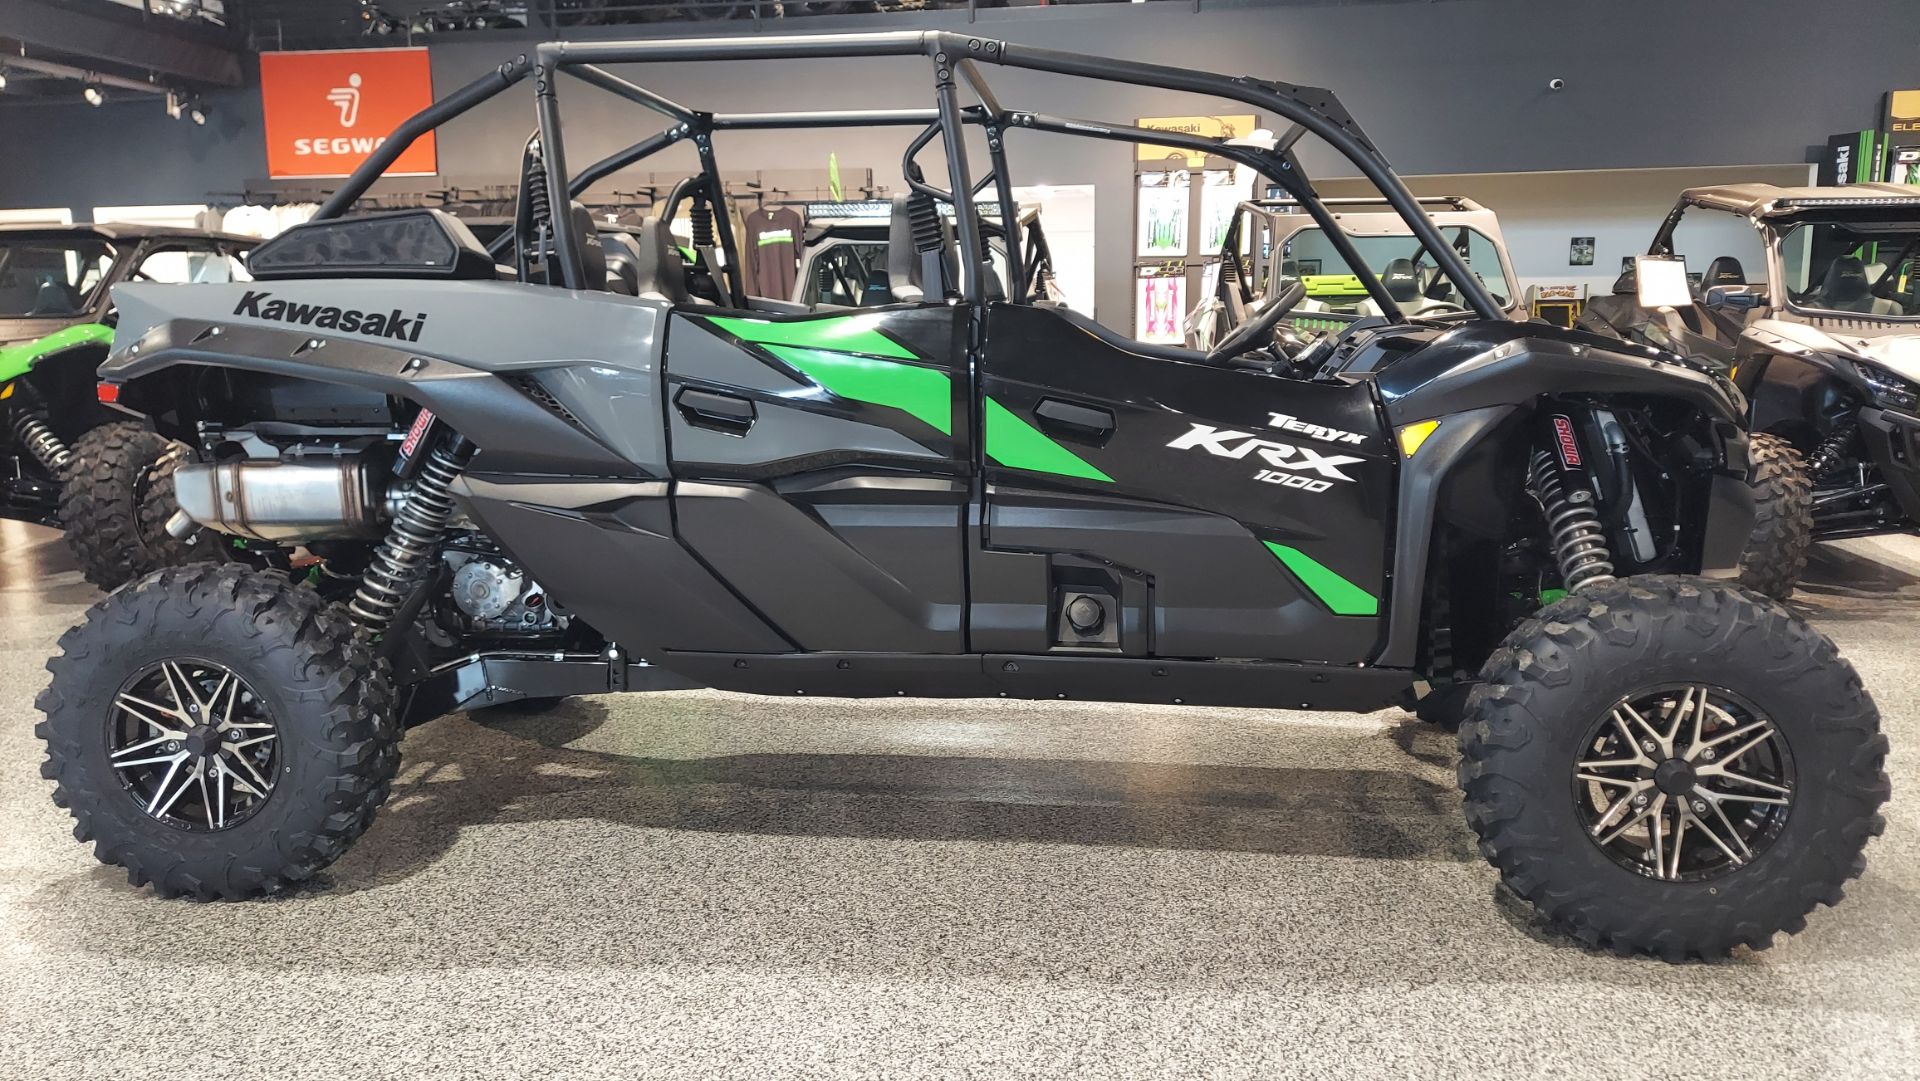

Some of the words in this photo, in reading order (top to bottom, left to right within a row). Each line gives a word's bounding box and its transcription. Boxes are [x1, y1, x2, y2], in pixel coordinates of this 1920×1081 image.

[233, 290, 427, 343] Kawasaki
[1165, 422, 1367, 482] KRX
[1554, 419, 1581, 465] SHOWA
[1253, 469, 1335, 493] 1000
